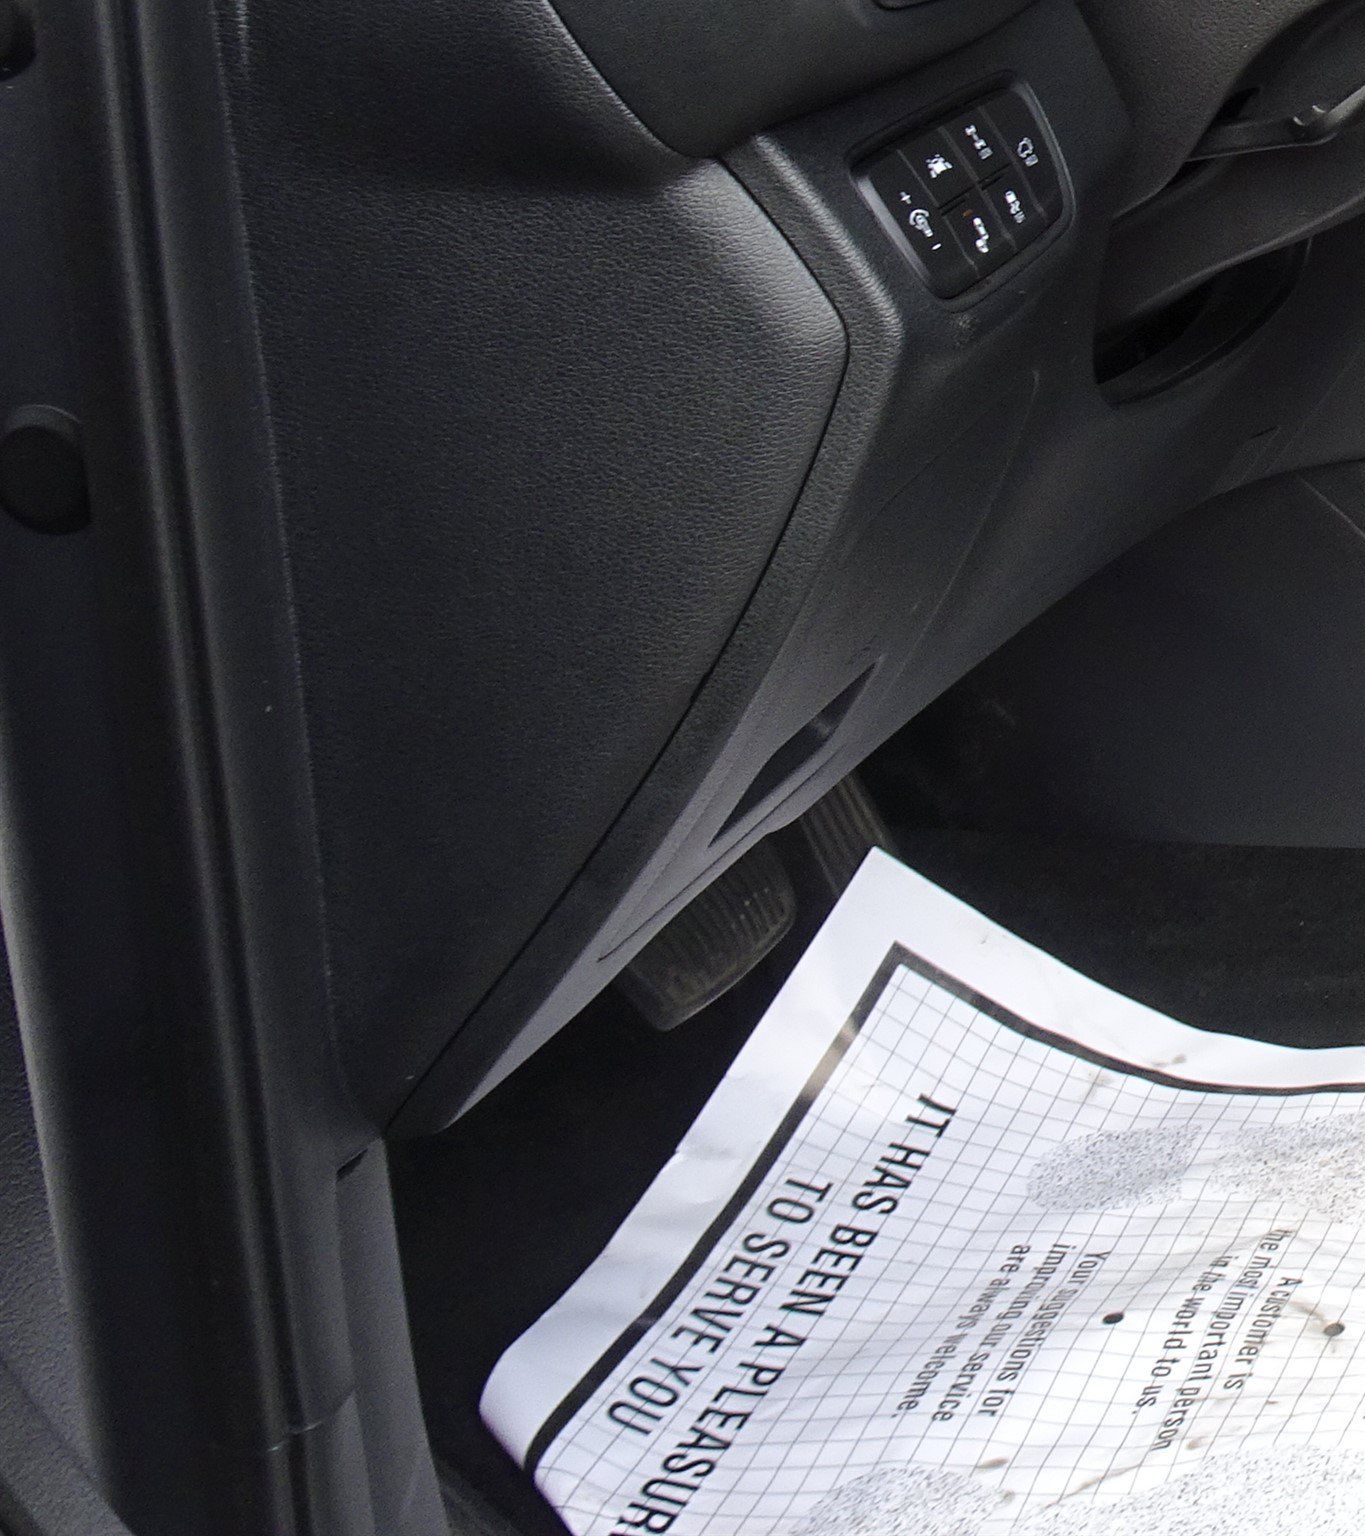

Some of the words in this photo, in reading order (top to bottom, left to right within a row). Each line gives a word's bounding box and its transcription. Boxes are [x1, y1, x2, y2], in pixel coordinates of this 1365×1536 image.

[905, 1093, 957, 1138] IT
[765, 1177, 835, 1225] TO
[851, 1141, 931, 1215] HAS
[1000, 1244, 1032, 1274] are
[1209, 1255, 1239, 1268] in
[1260, 1228, 1296, 1252] the
[778, 1223, 878, 1317] BEEN
[996, 1243, 1077, 1321] improving
[1066, 1250, 1113, 1286] Your
[1192, 1270, 1227, 1293] the
[1237, 1255, 1274, 1290] most
[1277, 1275, 1303, 1288] A
[671, 1231, 791, 1355] SERVE
[956, 1278, 1011, 1331] always
[753, 1324, 808, 1349] A
[979, 1322, 1014, 1348] our
[996, 1287, 1079, 1382] suggestions
[1163, 1296, 1206, 1350] world
[1188, 1290, 1255, 1382] important
[1234, 1289, 1291, 1365] customer
[890, 1331, 969, 1419] welcome.
[930, 1351, 991, 1423] service
[1151, 1358, 1181, 1378] to
[1223, 1372, 1254, 1391] is
[606, 1357, 704, 1436] YOU
[976, 1387, 1016, 1418] for
[1131, 1385, 1164, 1415] us.
[1150, 1385, 1201, 1451] person
[608, 1361, 786, 1536] PLEASUR
